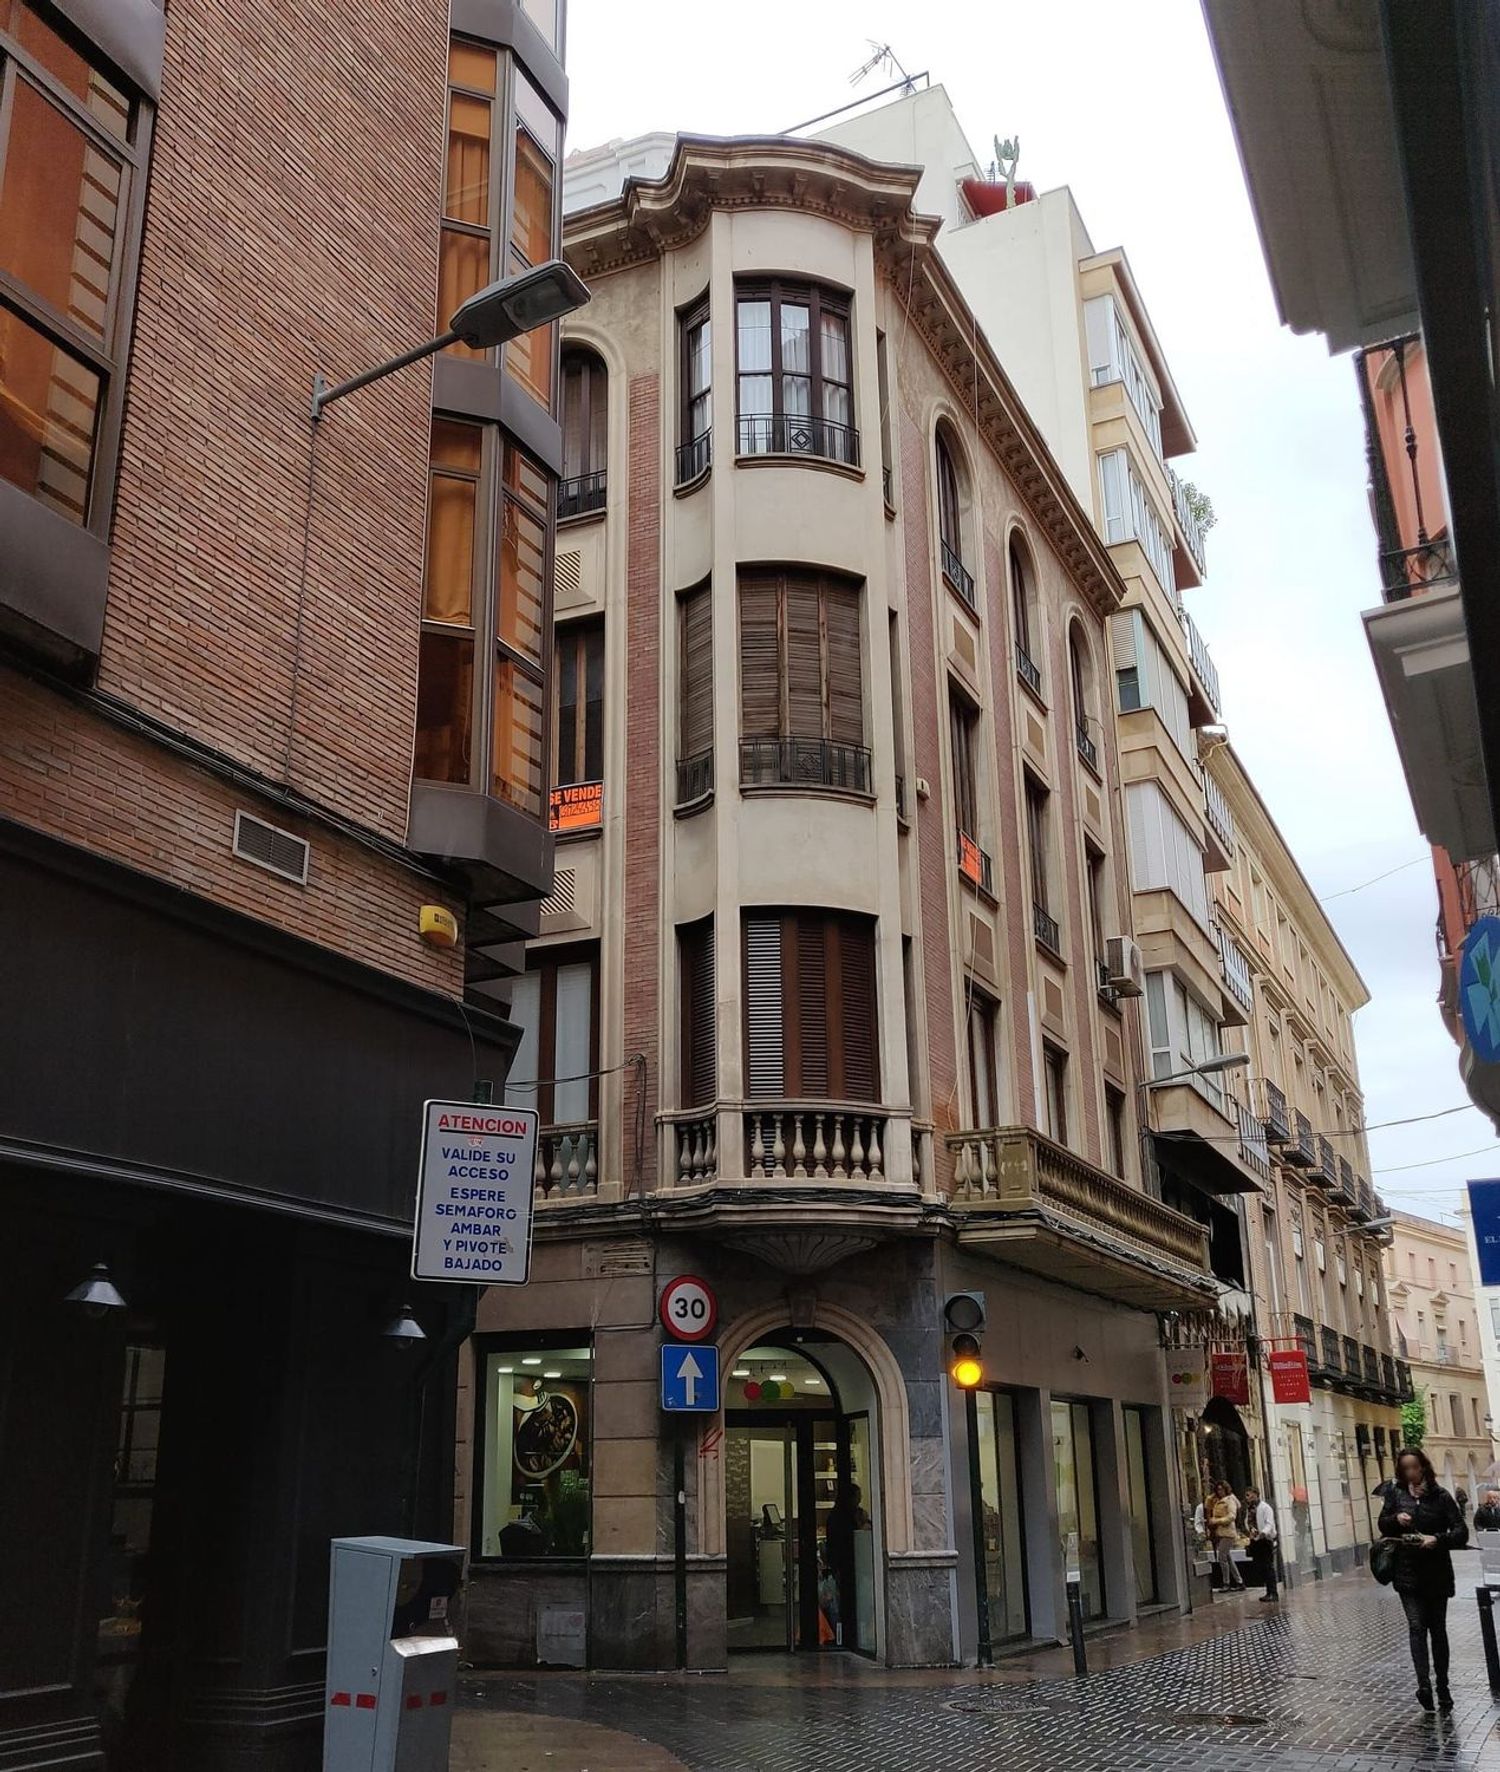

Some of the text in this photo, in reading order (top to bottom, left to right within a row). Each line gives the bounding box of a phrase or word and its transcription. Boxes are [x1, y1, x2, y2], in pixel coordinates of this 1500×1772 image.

[563, 784, 602, 803] VENDE
[438, 1114, 527, 1135] ATENCION
[442, 1147, 516, 1164] VALIDE SU
[448, 1165, 509, 1181] ACCESO
[450, 1187, 506, 1203] ESPERE
[435, 1203, 517, 1220] SEMAFORO
[450, 1222, 501, 1237] AMBAR
[443, 1239, 507, 1254] Y PIVOTE
[444, 1257, 503, 1271] BAJADO
[675, 1297, 706, 1319] 30
